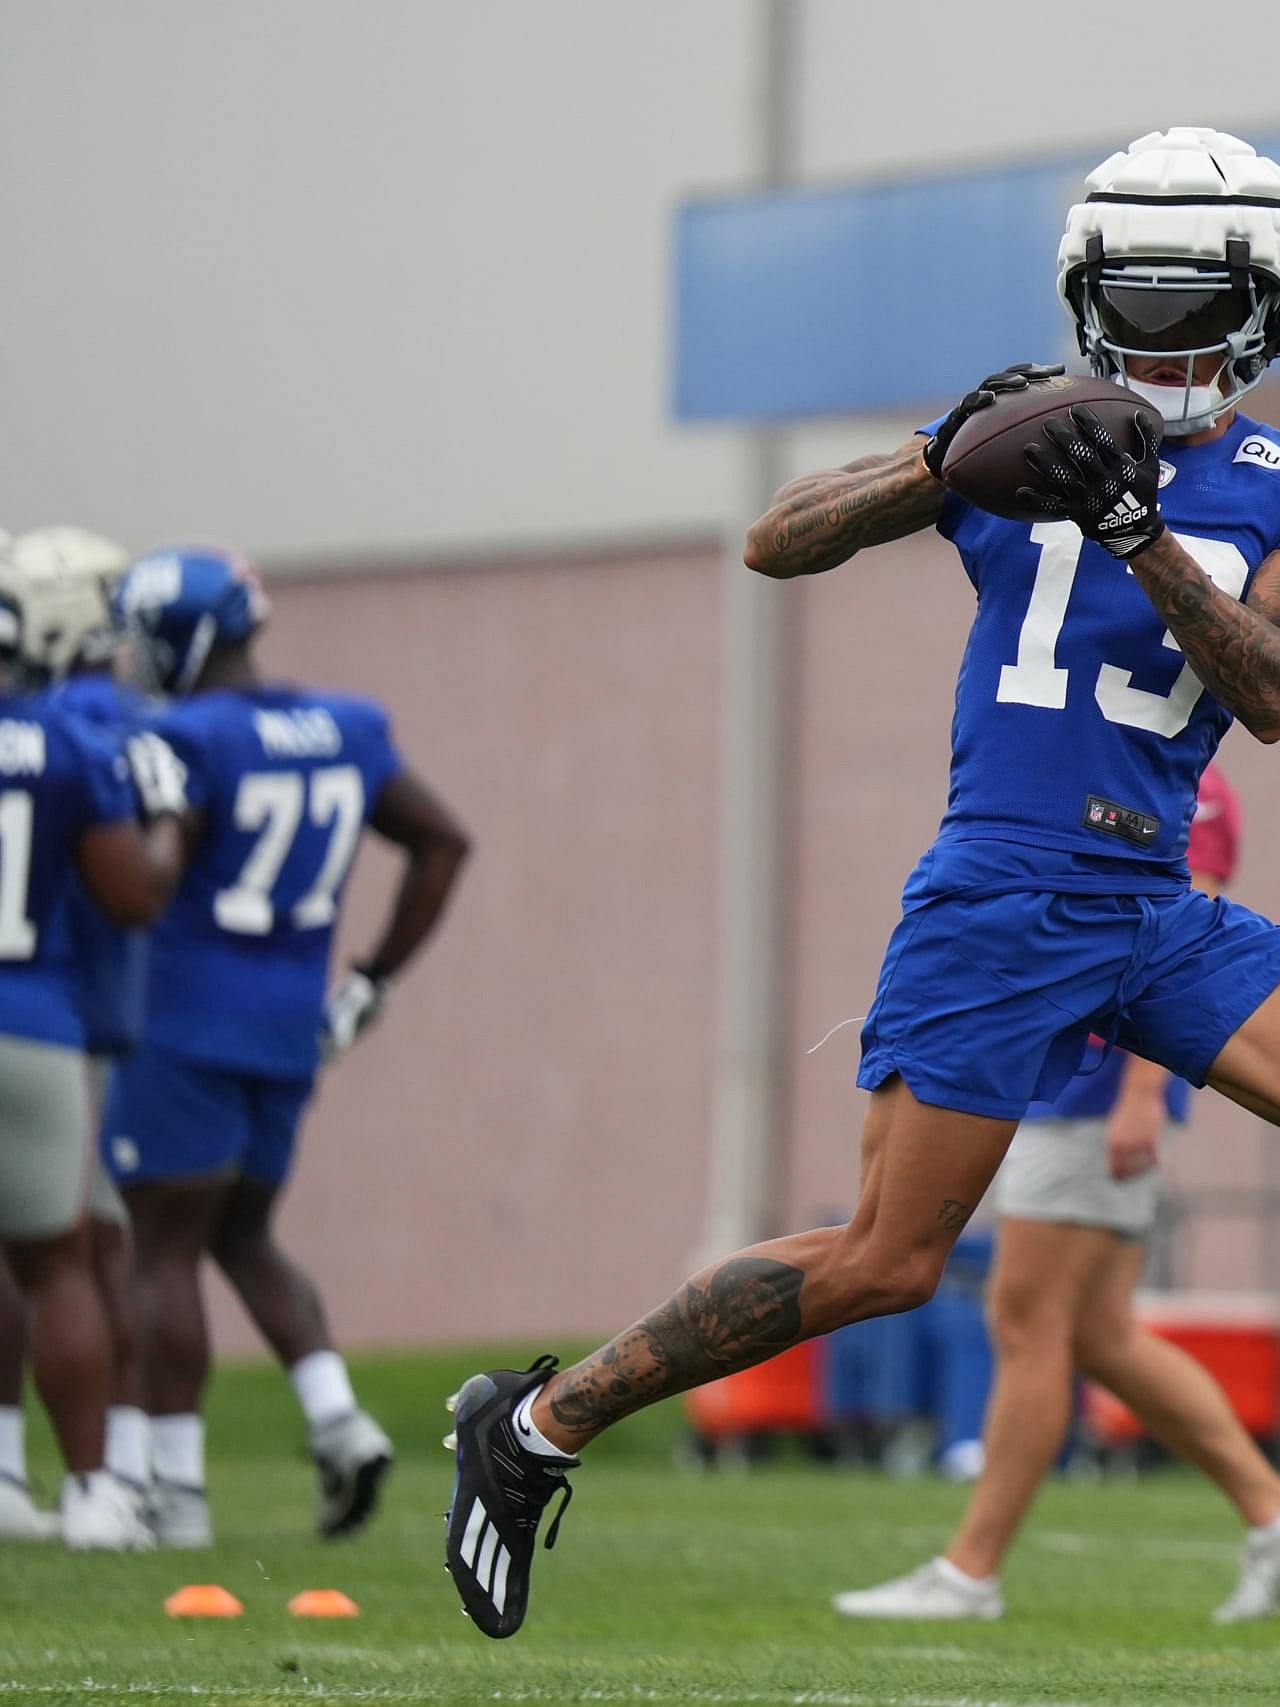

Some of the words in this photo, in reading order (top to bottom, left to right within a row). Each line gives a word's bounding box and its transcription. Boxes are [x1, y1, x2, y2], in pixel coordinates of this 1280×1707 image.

[1098, 505, 1148, 531] adidas
[996, 518, 1250, 740] 13
[212, 764, 366, 936] 77
